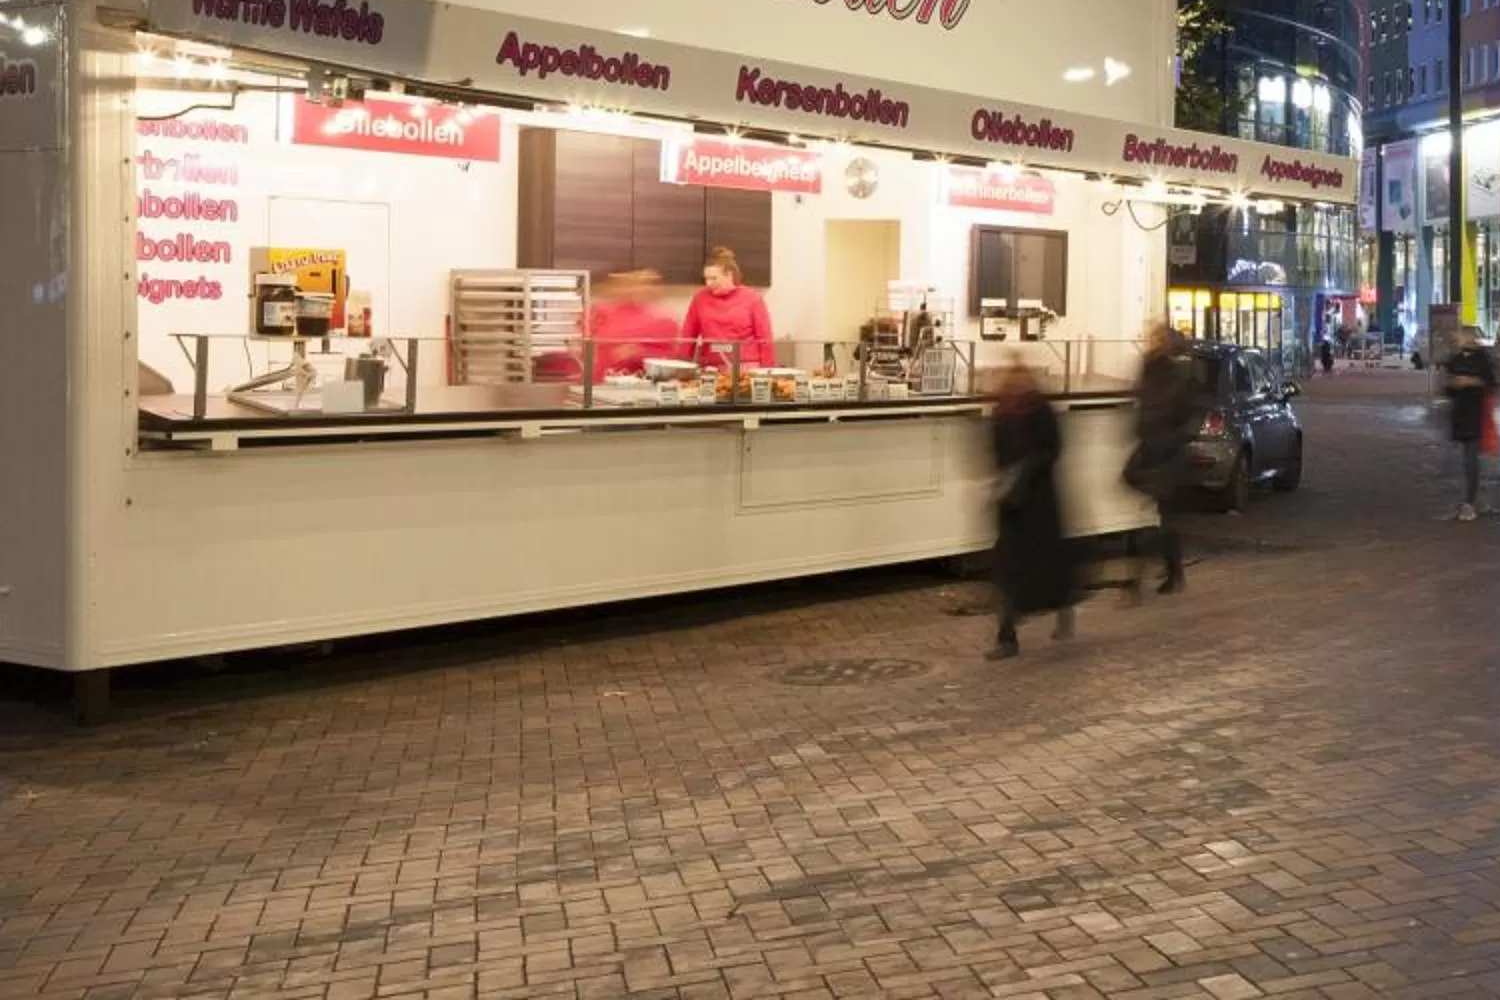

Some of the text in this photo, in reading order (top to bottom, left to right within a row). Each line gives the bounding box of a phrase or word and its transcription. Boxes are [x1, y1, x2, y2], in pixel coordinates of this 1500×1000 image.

[495, 31, 671, 91] Appelbollen
[735, 64, 910, 128] Kersenbollen
[971, 109, 1075, 154] Oliebollen
[1122, 133, 1238, 176] Berlinerbollen
